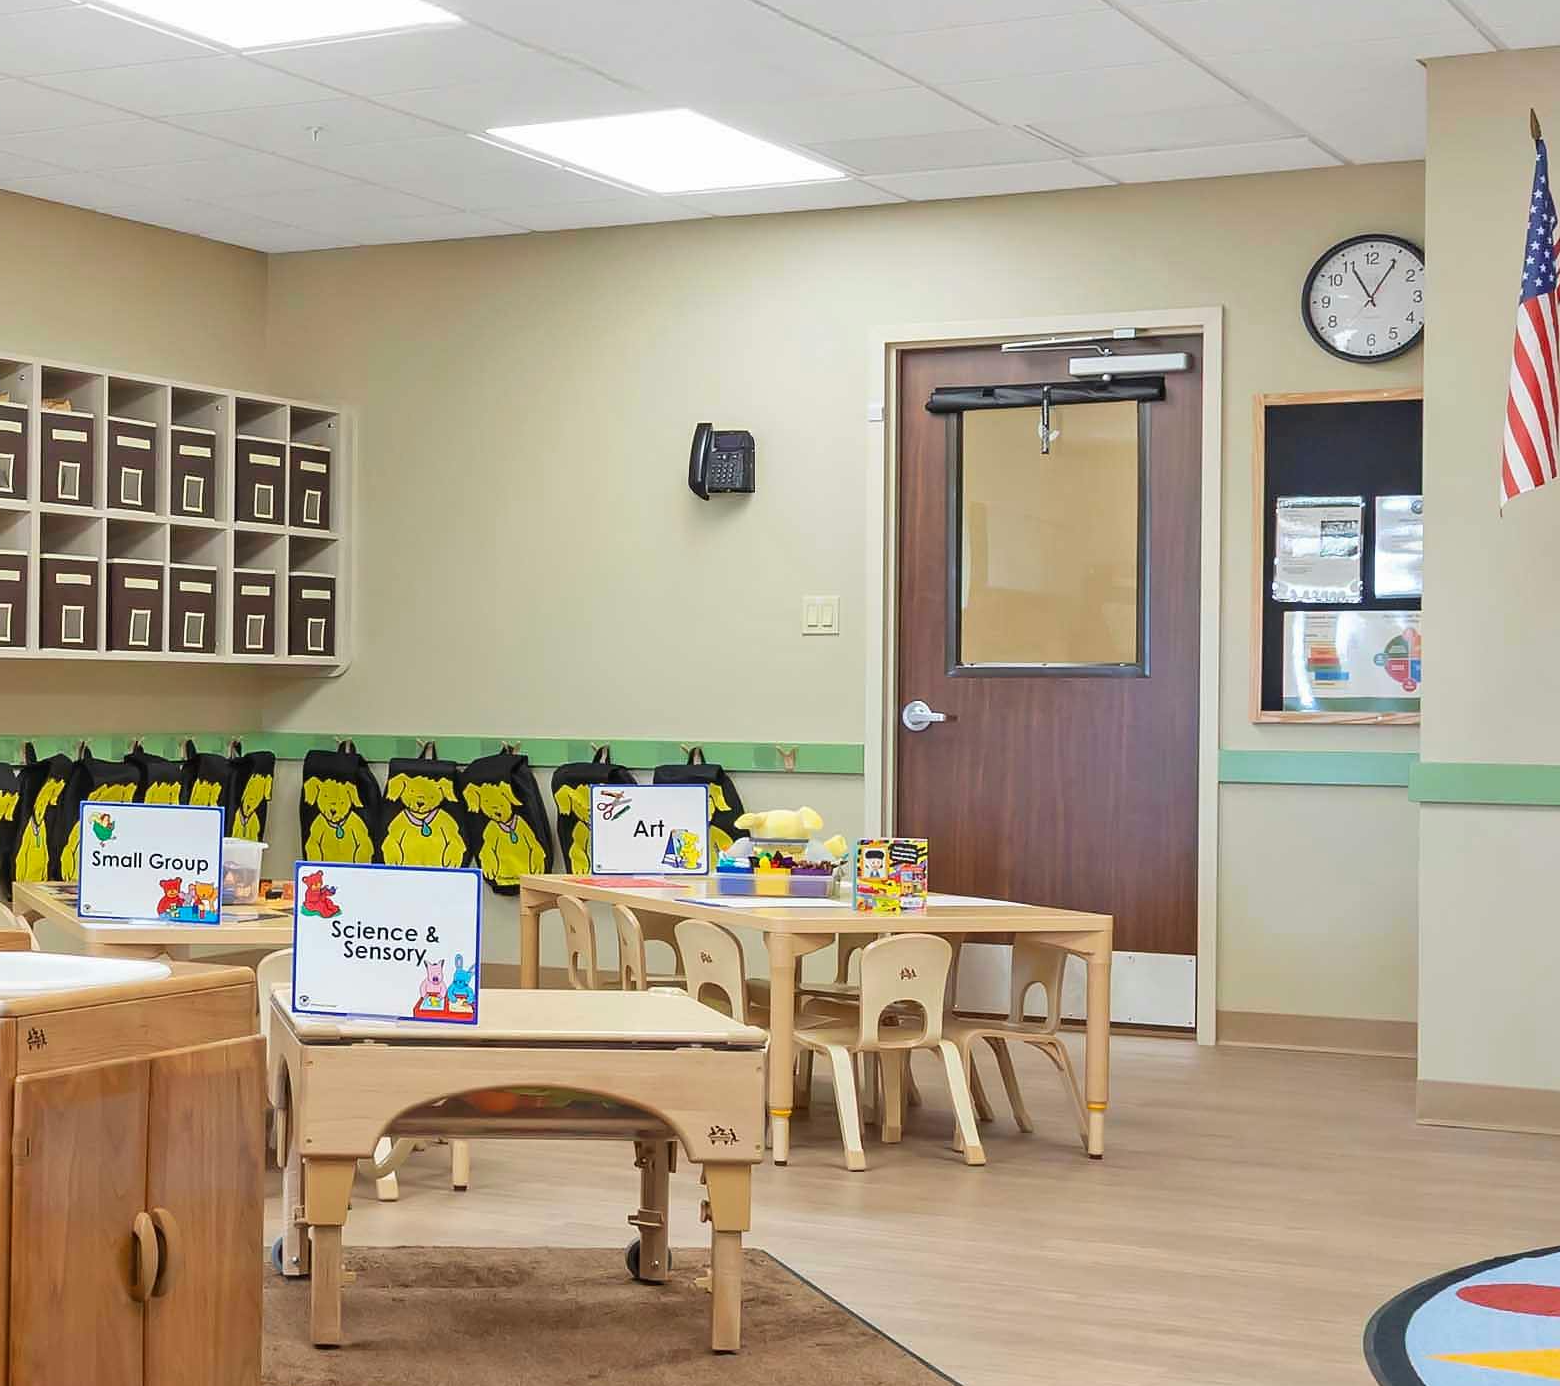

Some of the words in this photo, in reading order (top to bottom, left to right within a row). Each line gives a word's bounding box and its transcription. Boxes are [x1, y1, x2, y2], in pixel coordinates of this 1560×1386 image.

[1365, 252, 1380, 265] 12
[1343, 260, 1355, 273] 11
[1328, 273, 1343, 286] 10
[1405, 268, 1416, 282] 2
[1321, 295, 1331, 308] 9
[1413, 289, 1423, 303] 3
[1327, 315, 1338, 328] 8
[1405, 311, 1415, 324] 4
[1388, 327, 1398, 340] 5
[1366, 334, 1376, 347] 6
[633, 819, 665, 838] Art
[91, 850, 142, 869] Small
[149, 853, 209, 875] Group
[331, 920, 418, 943] Science
[426, 925, 440, 944] &
[343, 940, 427, 967] Sensory
